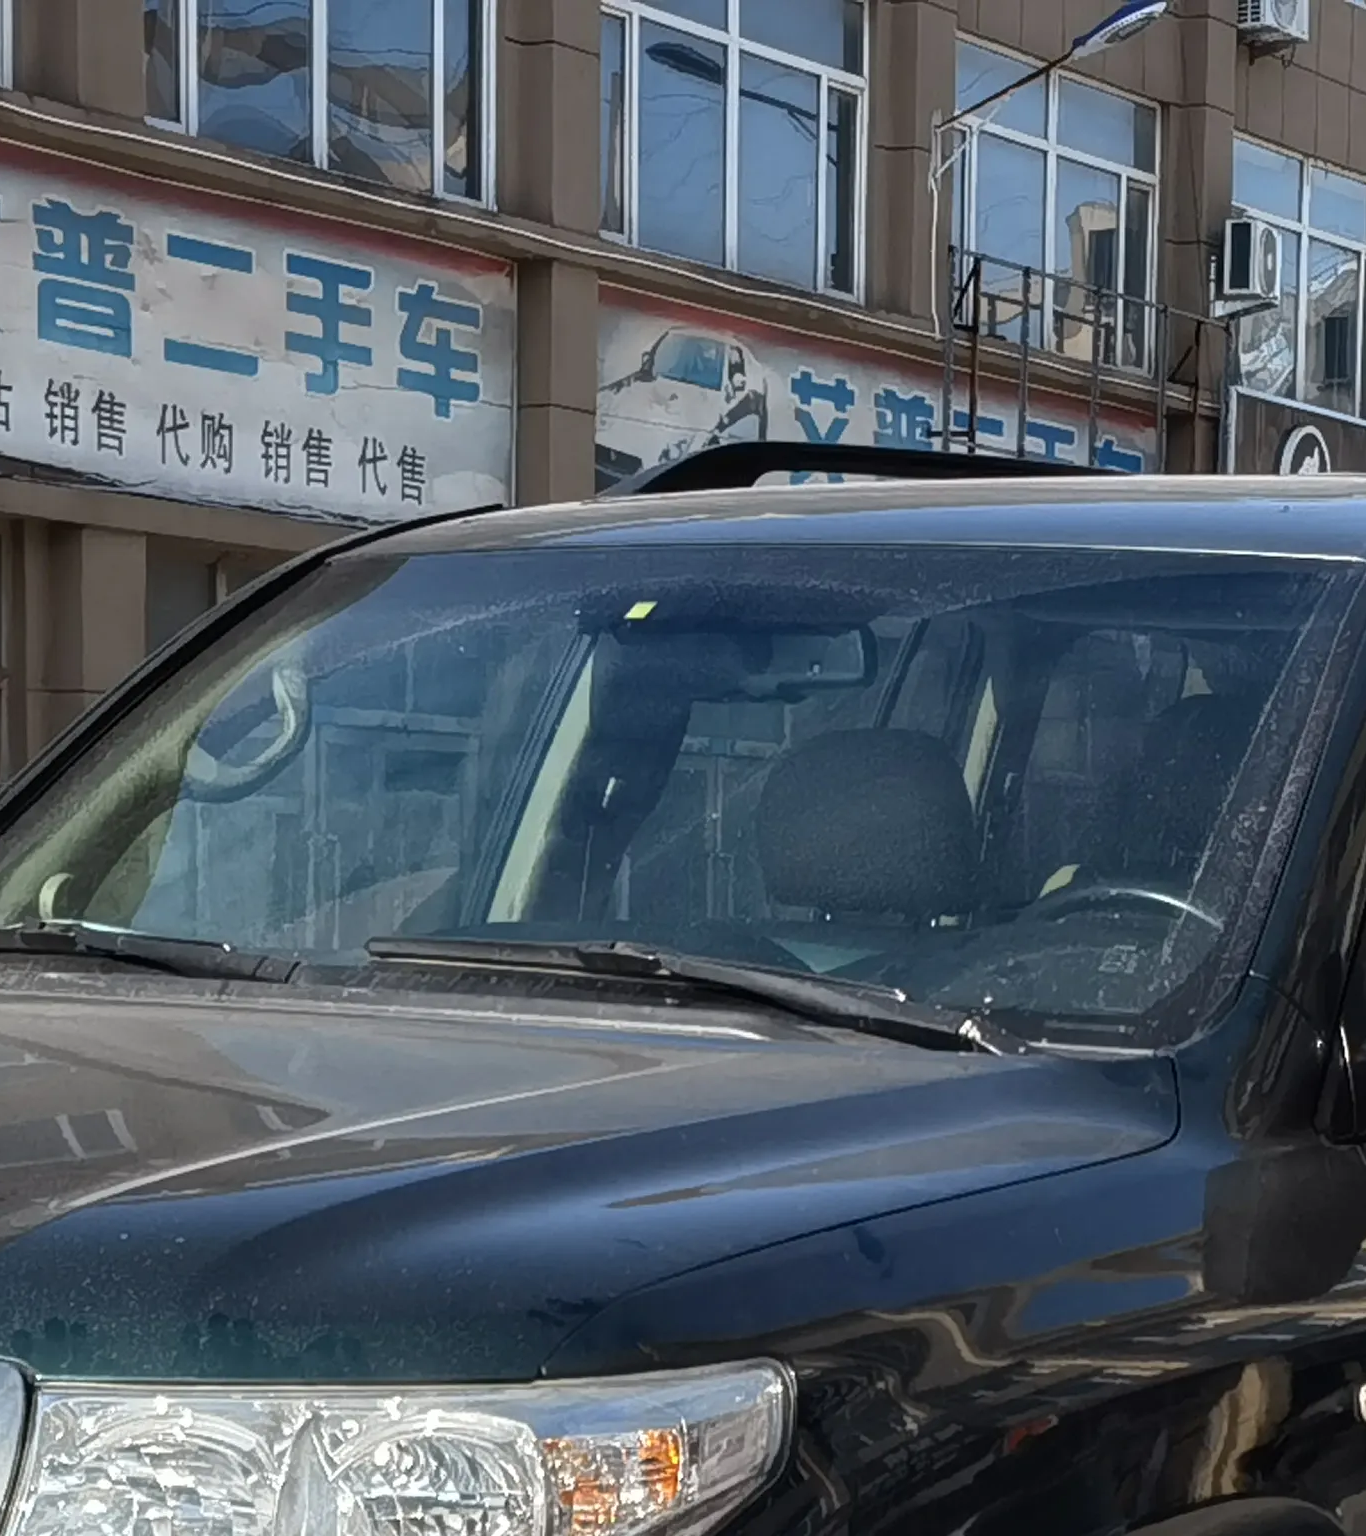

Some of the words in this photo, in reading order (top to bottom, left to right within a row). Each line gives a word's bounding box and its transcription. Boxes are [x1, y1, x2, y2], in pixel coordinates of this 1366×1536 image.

[43, 378, 128, 457] 销售
[156, 402, 234, 477] 代购
[260, 420, 334, 491] 销售
[358, 436, 428, 506] 代售
